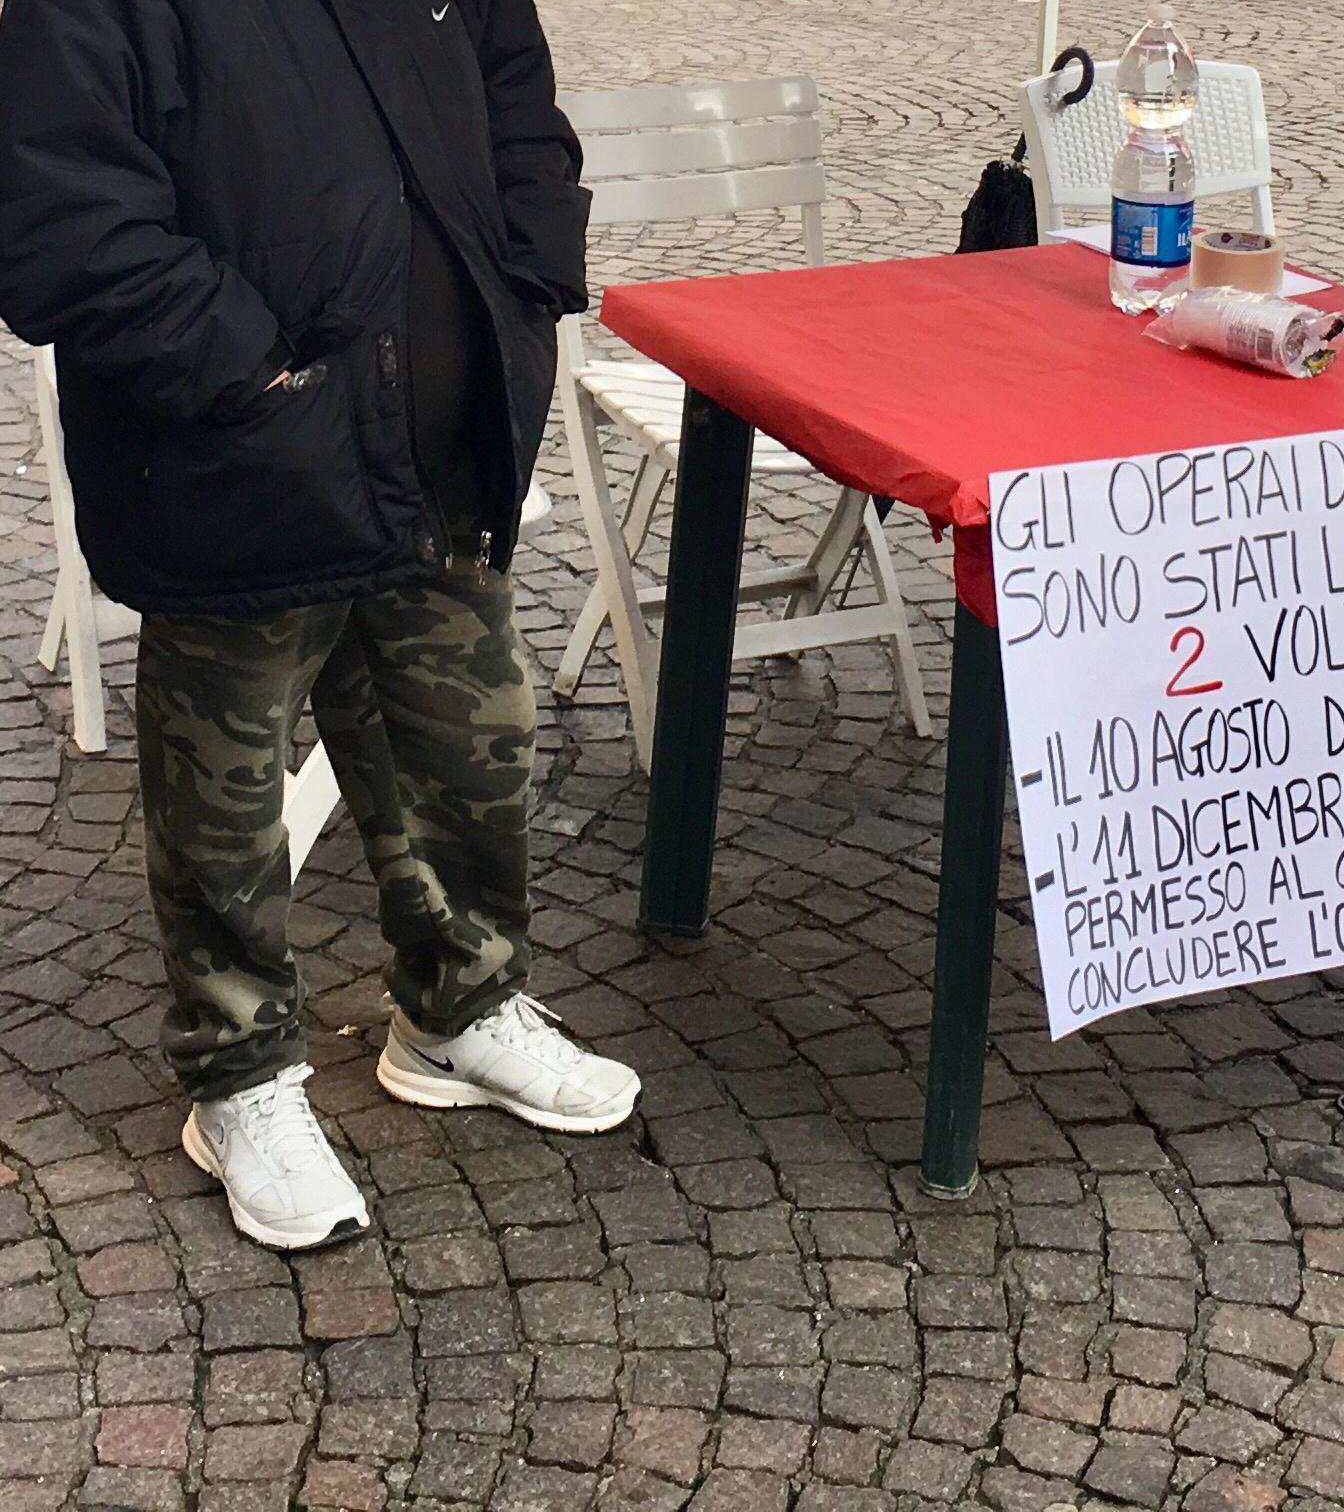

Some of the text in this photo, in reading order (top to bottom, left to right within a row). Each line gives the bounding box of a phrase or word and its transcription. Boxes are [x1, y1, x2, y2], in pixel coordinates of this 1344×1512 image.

[996, 471, 1075, 551] GLI
[1108, 445, 1303, 536] OPERAI
[1002, 553, 1141, 646] SONO
[1163, 530, 1301, 619] STATI
[1165, 625, 1224, 697] 2
[1089, 717, 1141, 800] 10
[1152, 699, 1291, 787] AGOSTO
[1064, 861, 1247, 957] PERMESSO
[1269, 854, 1325, 905] AL
[1067, 917, 1287, 1015] CONCLUDERE
